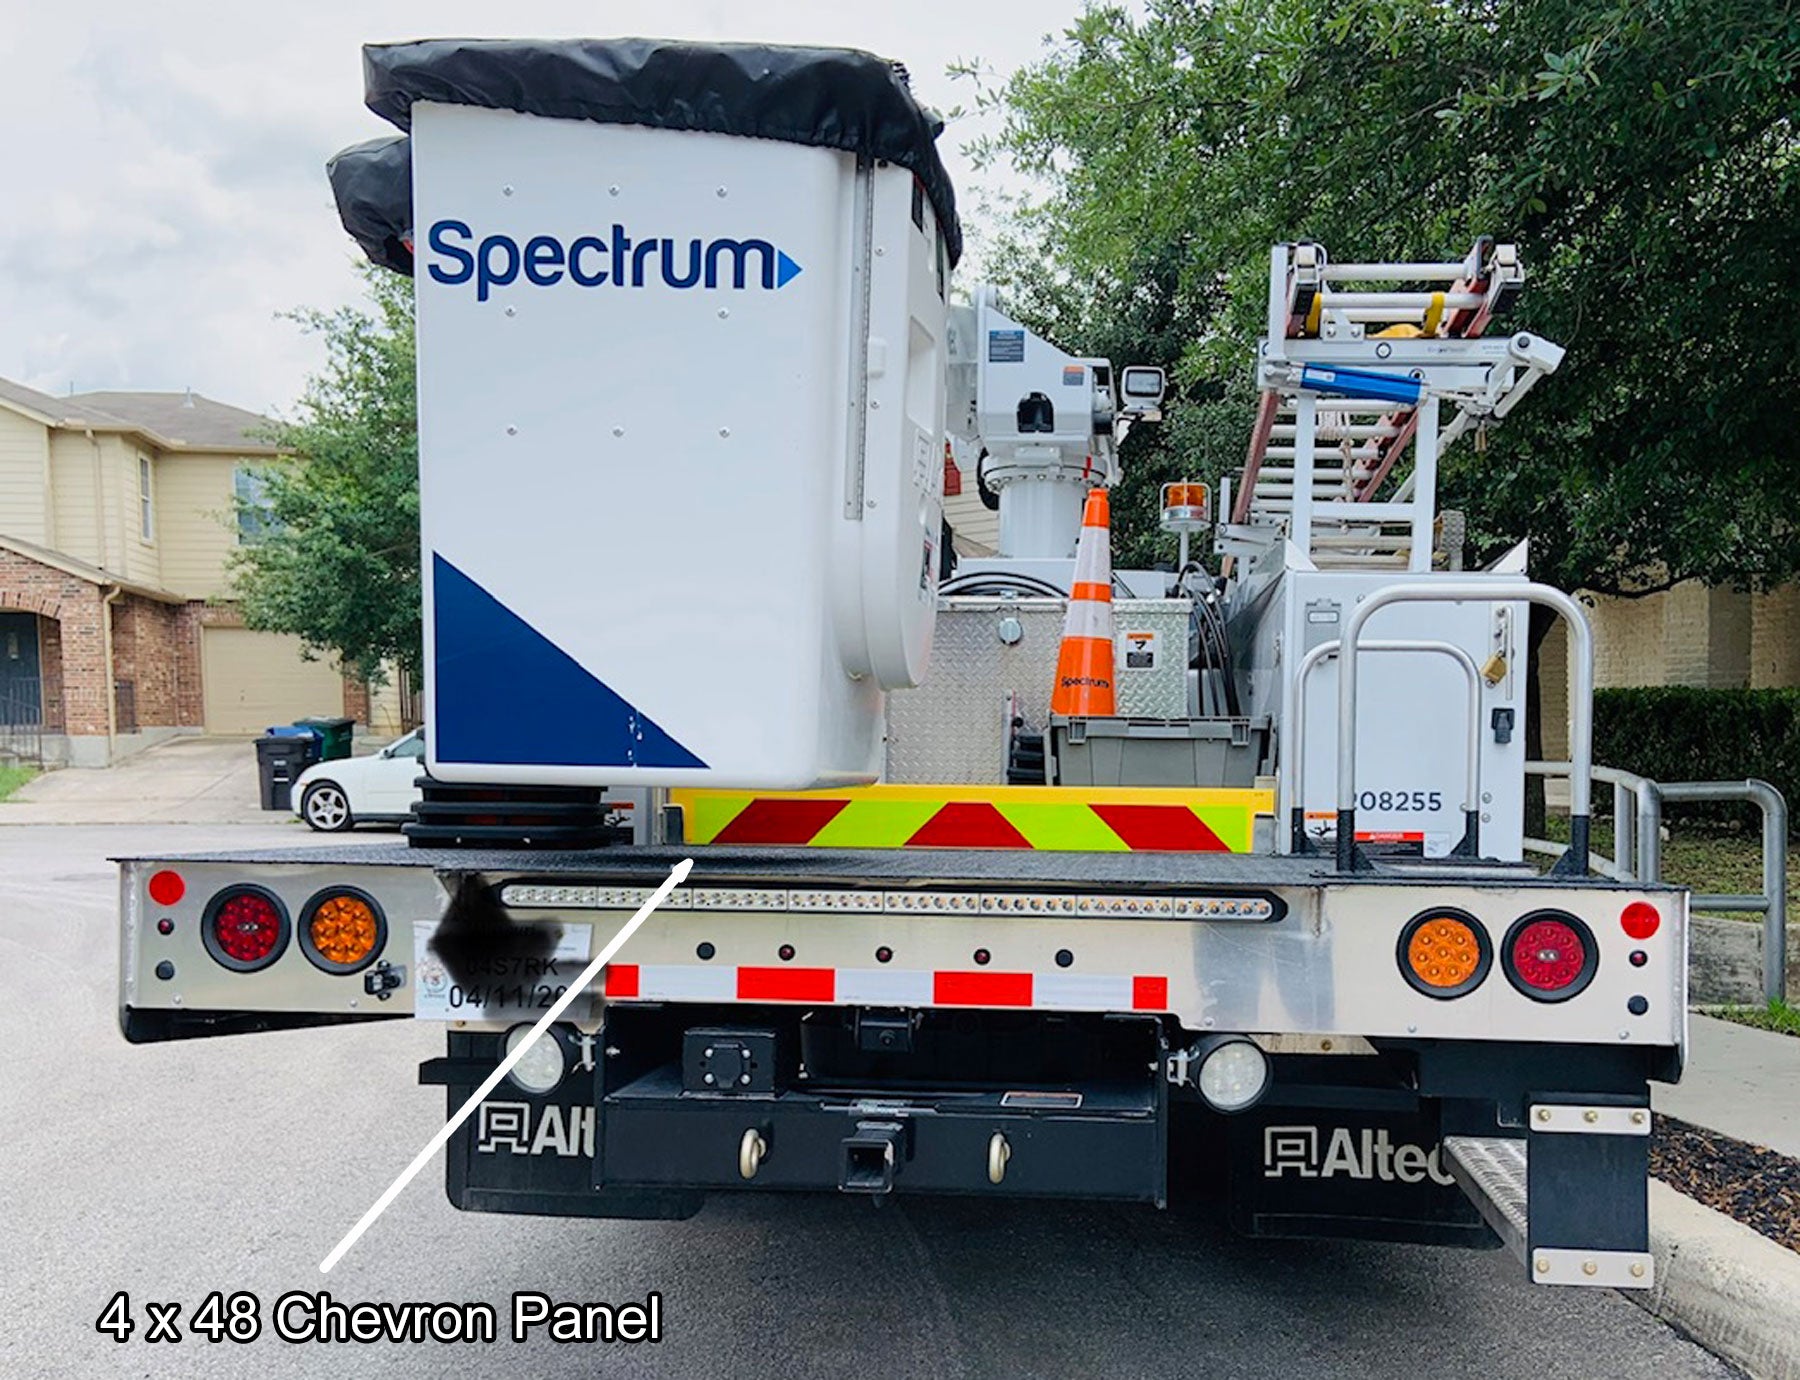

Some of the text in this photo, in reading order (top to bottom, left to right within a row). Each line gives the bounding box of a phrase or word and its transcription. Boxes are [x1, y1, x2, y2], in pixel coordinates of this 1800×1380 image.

[427, 220, 774, 302] Spectrum
[1061, 676, 1110, 688] Spectrum
[1354, 791, 1442, 811] 08255
[530, 1105, 595, 1158] Alt
